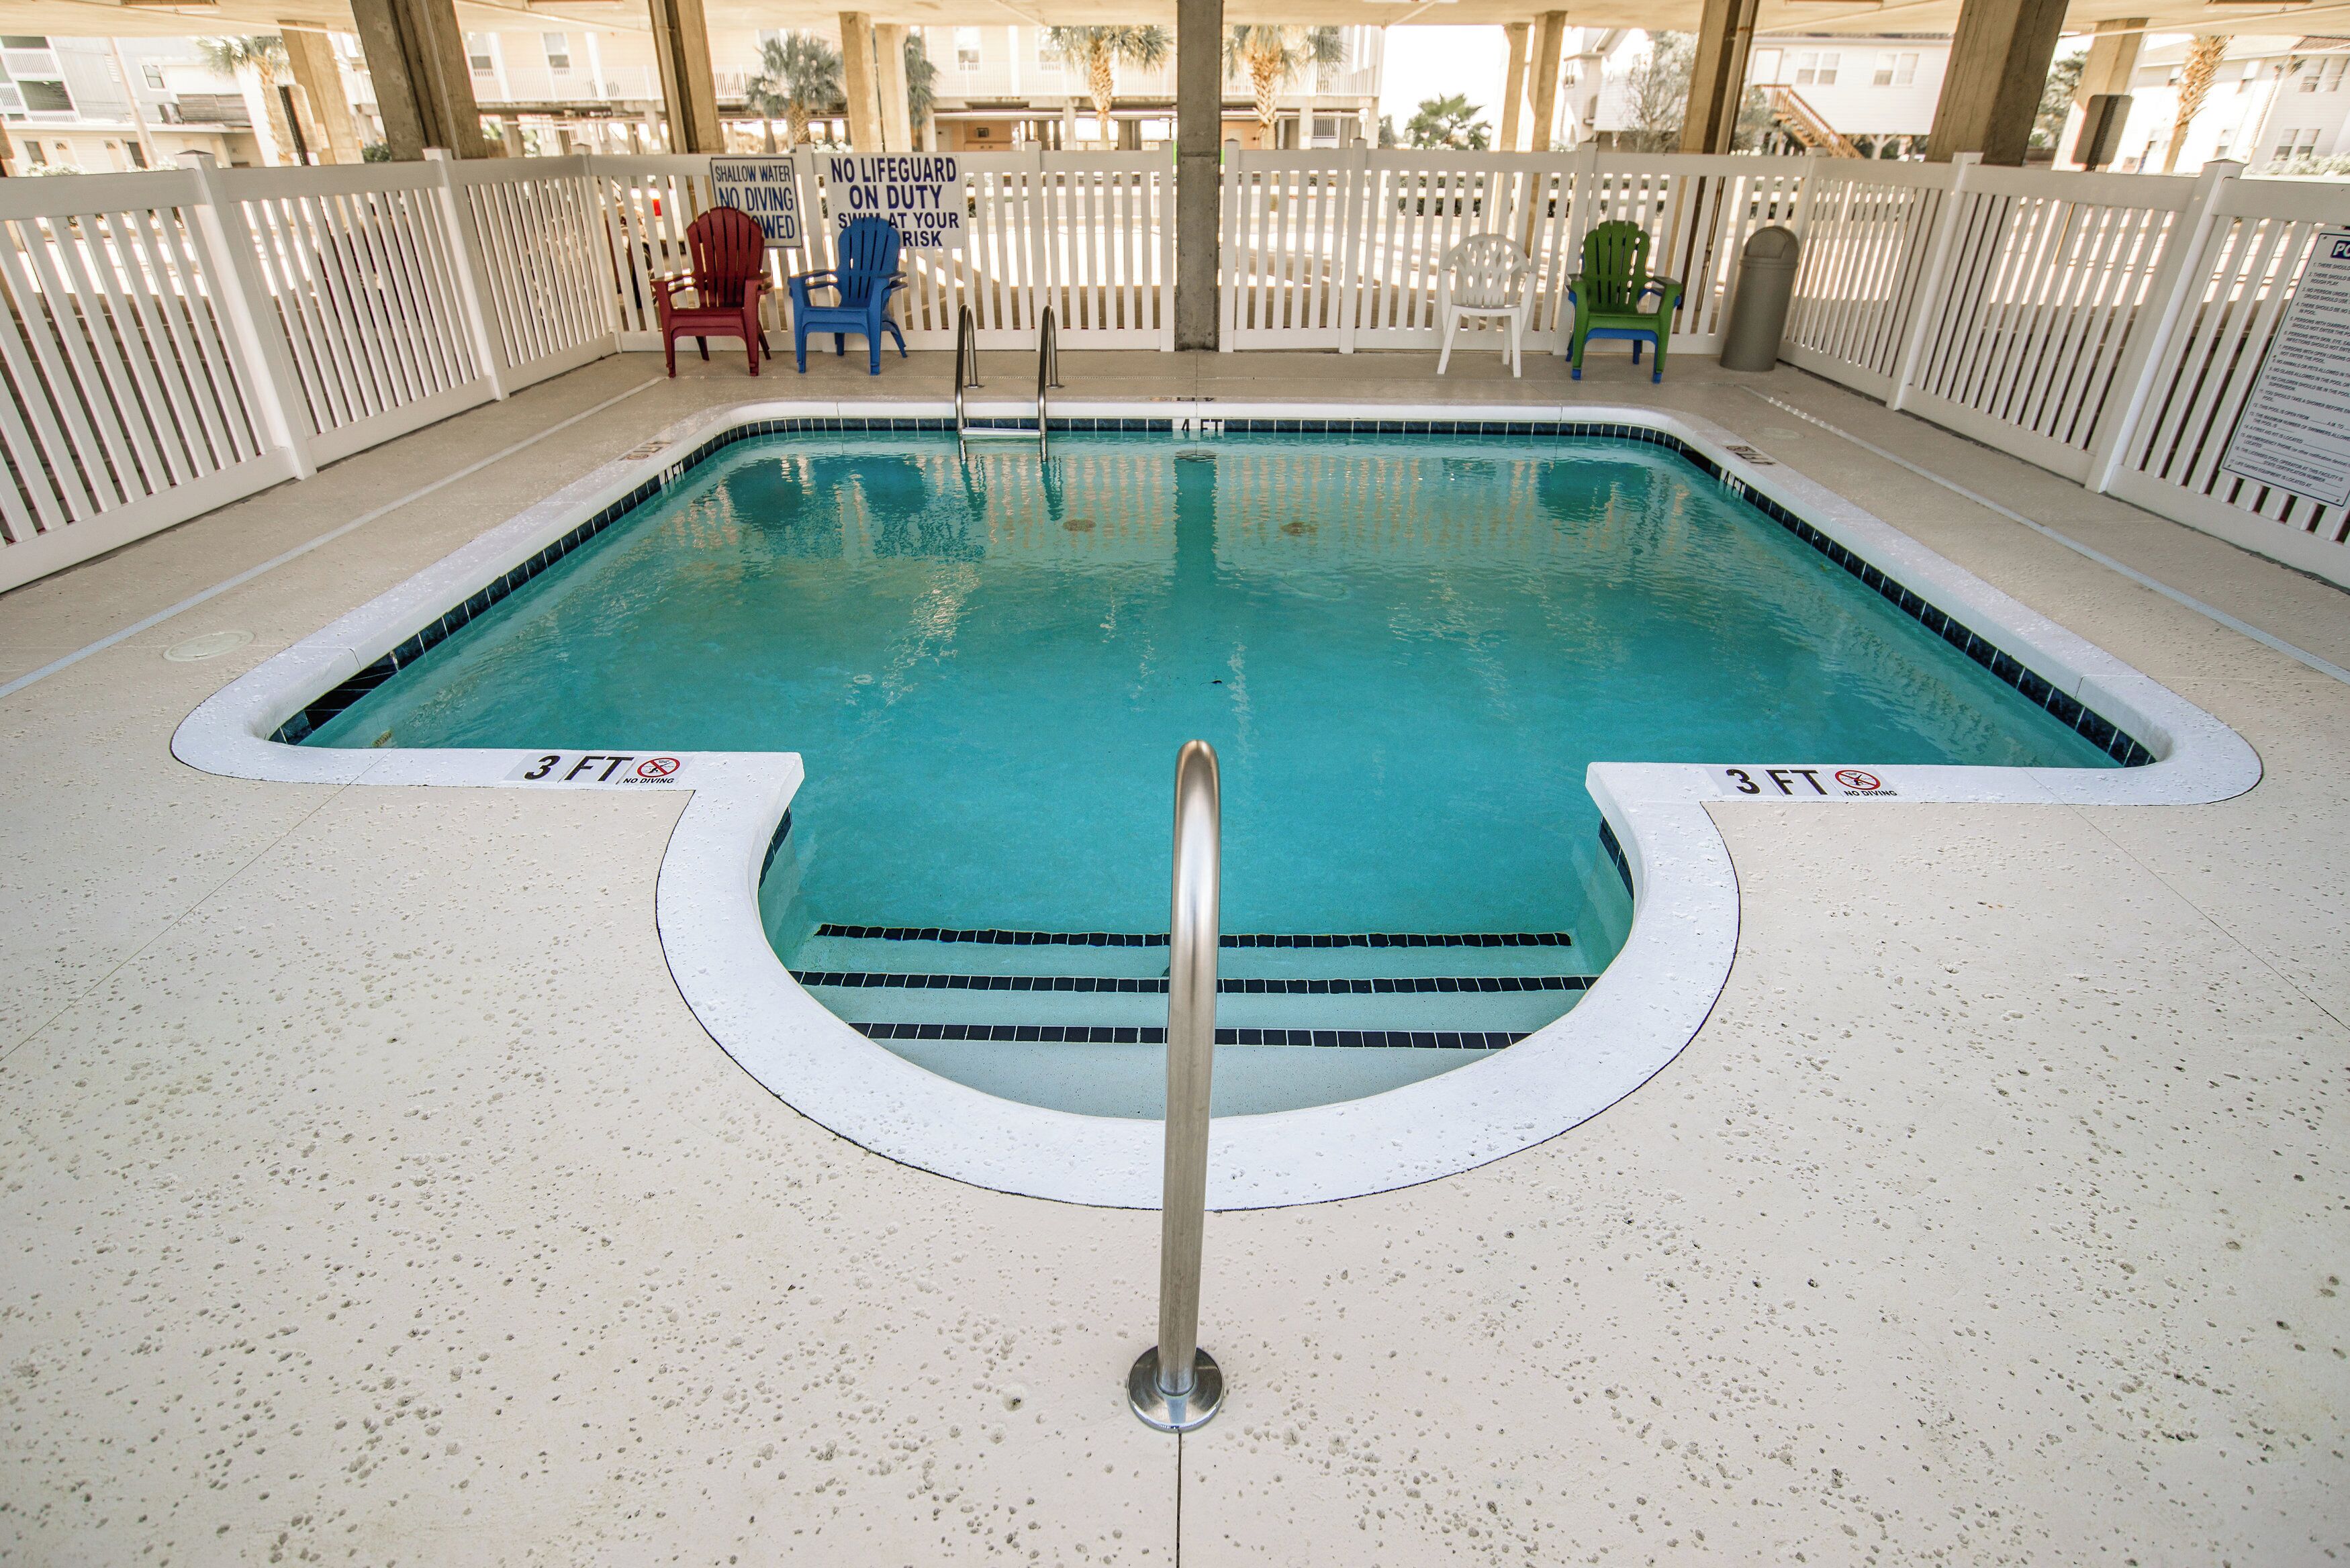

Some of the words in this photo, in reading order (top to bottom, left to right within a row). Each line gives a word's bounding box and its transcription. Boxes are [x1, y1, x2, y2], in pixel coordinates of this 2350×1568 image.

[715, 165, 756, 182] SHALLOW
[759, 165, 791, 182] WATER
[831, 157, 855, 183] NO
[861, 157, 957, 183] LIFEGUARD
[718, 187, 740, 210] NO
[745, 187, 794, 211] DIVING
[849, 185, 879, 209] ON
[886, 185, 943, 209] DUTY
[888, 212, 907, 228] AT
[913, 212, 959, 228] YOUR
[902, 230, 943, 247] RISK
[1201, 418, 1223, 432] FT
[524, 755, 561, 780] 3
[564, 756, 634, 781] FT
[1726, 769, 1760, 795] 3
[1765, 769, 1828, 795] FT
